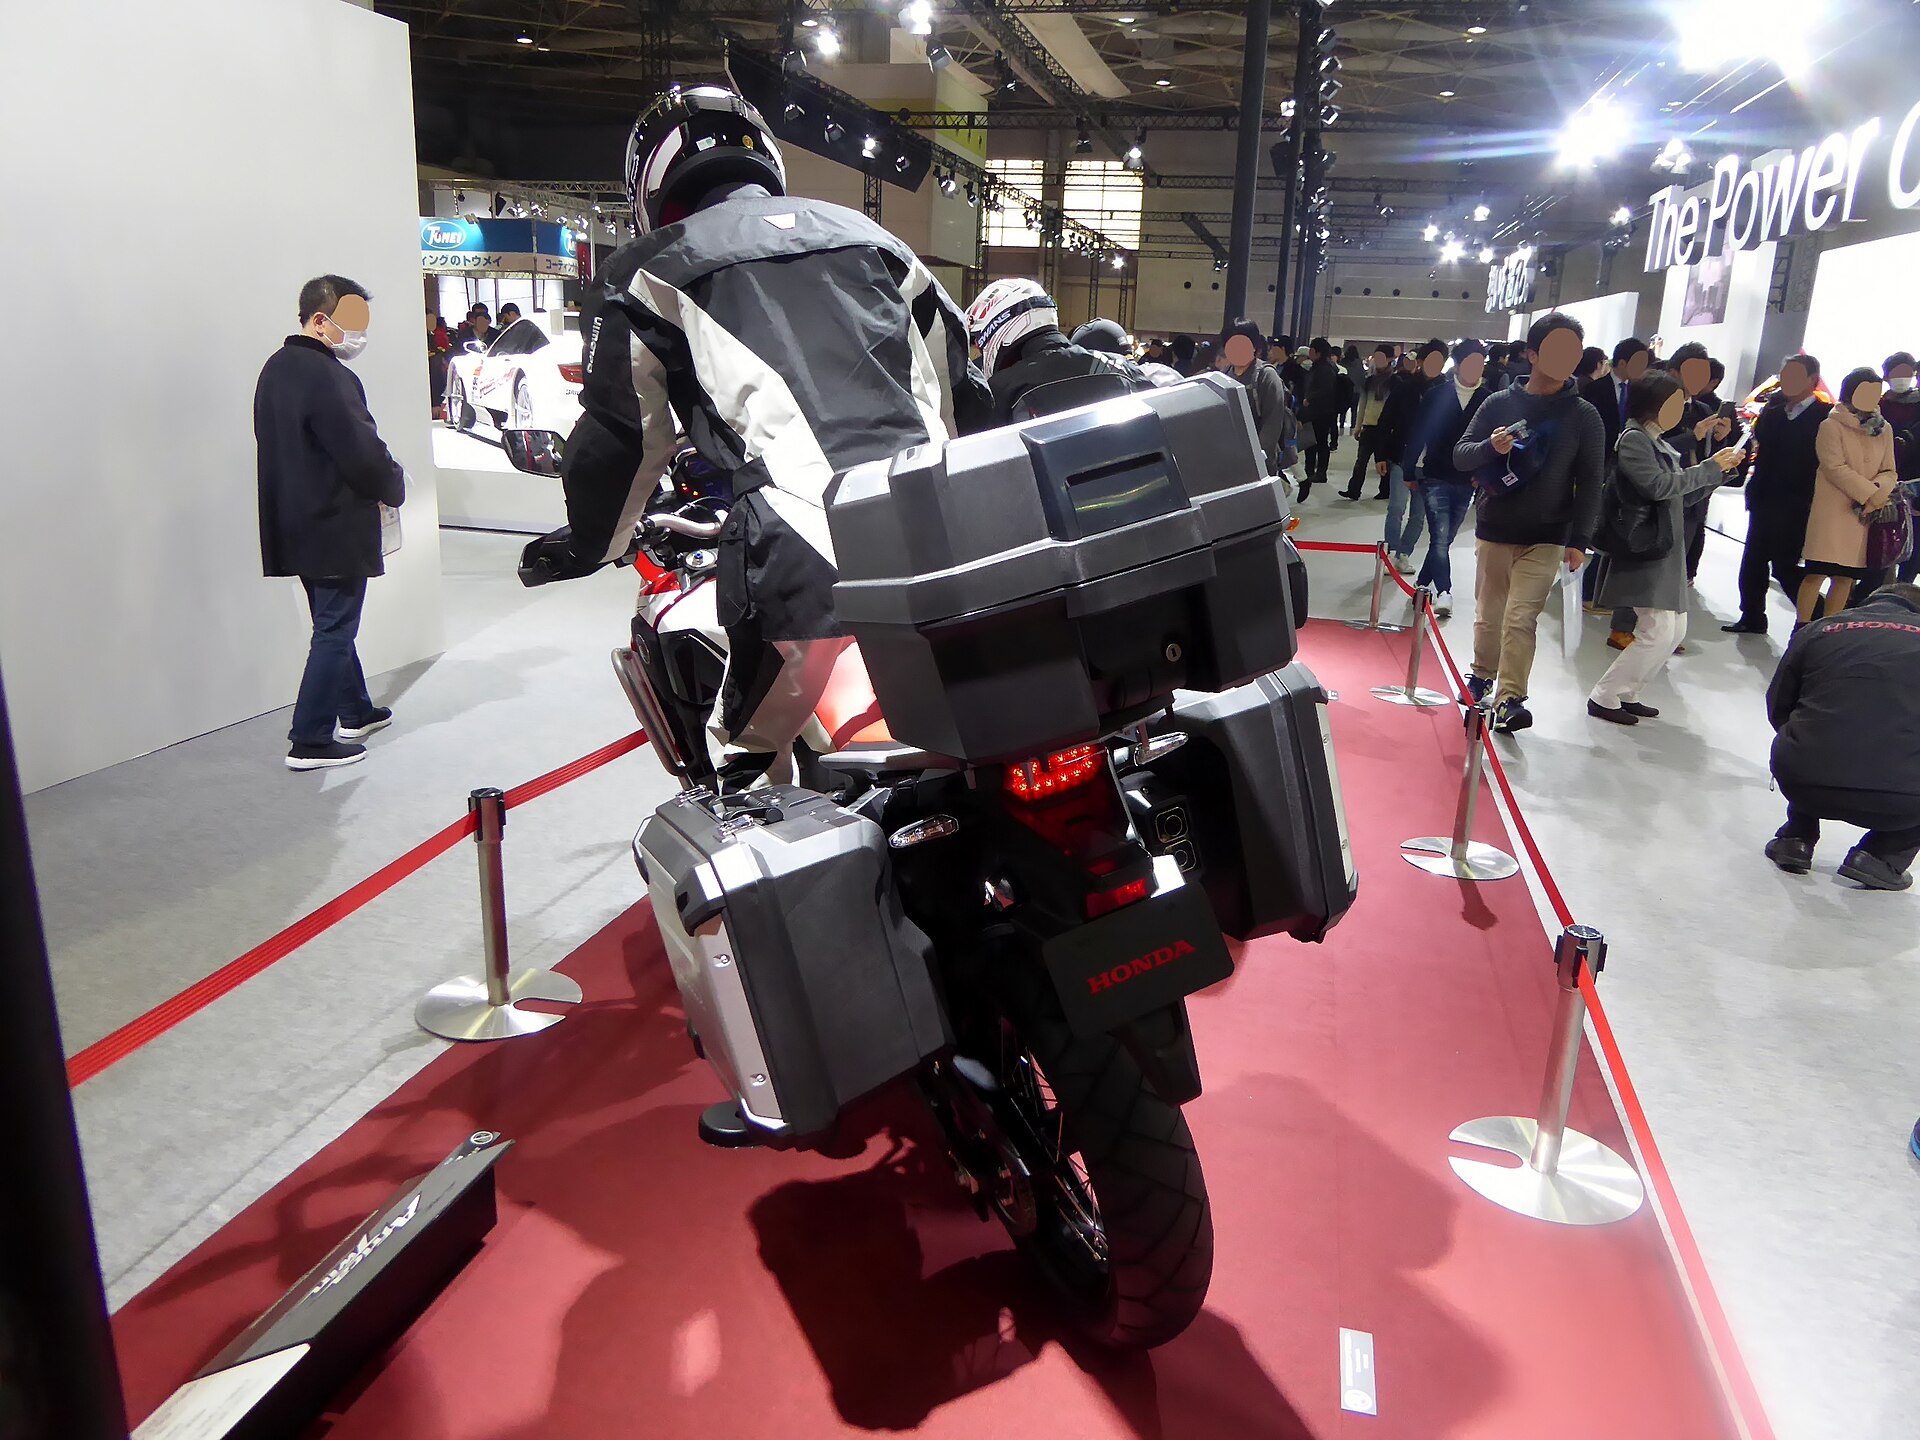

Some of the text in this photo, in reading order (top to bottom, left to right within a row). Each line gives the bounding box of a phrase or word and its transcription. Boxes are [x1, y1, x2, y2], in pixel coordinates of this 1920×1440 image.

[1644, 184, 1700, 273] The
[1702, 116, 1881, 259] Power
[977, 309, 1011, 348] SWANS
[1086, 939, 1197, 994] HONDA
